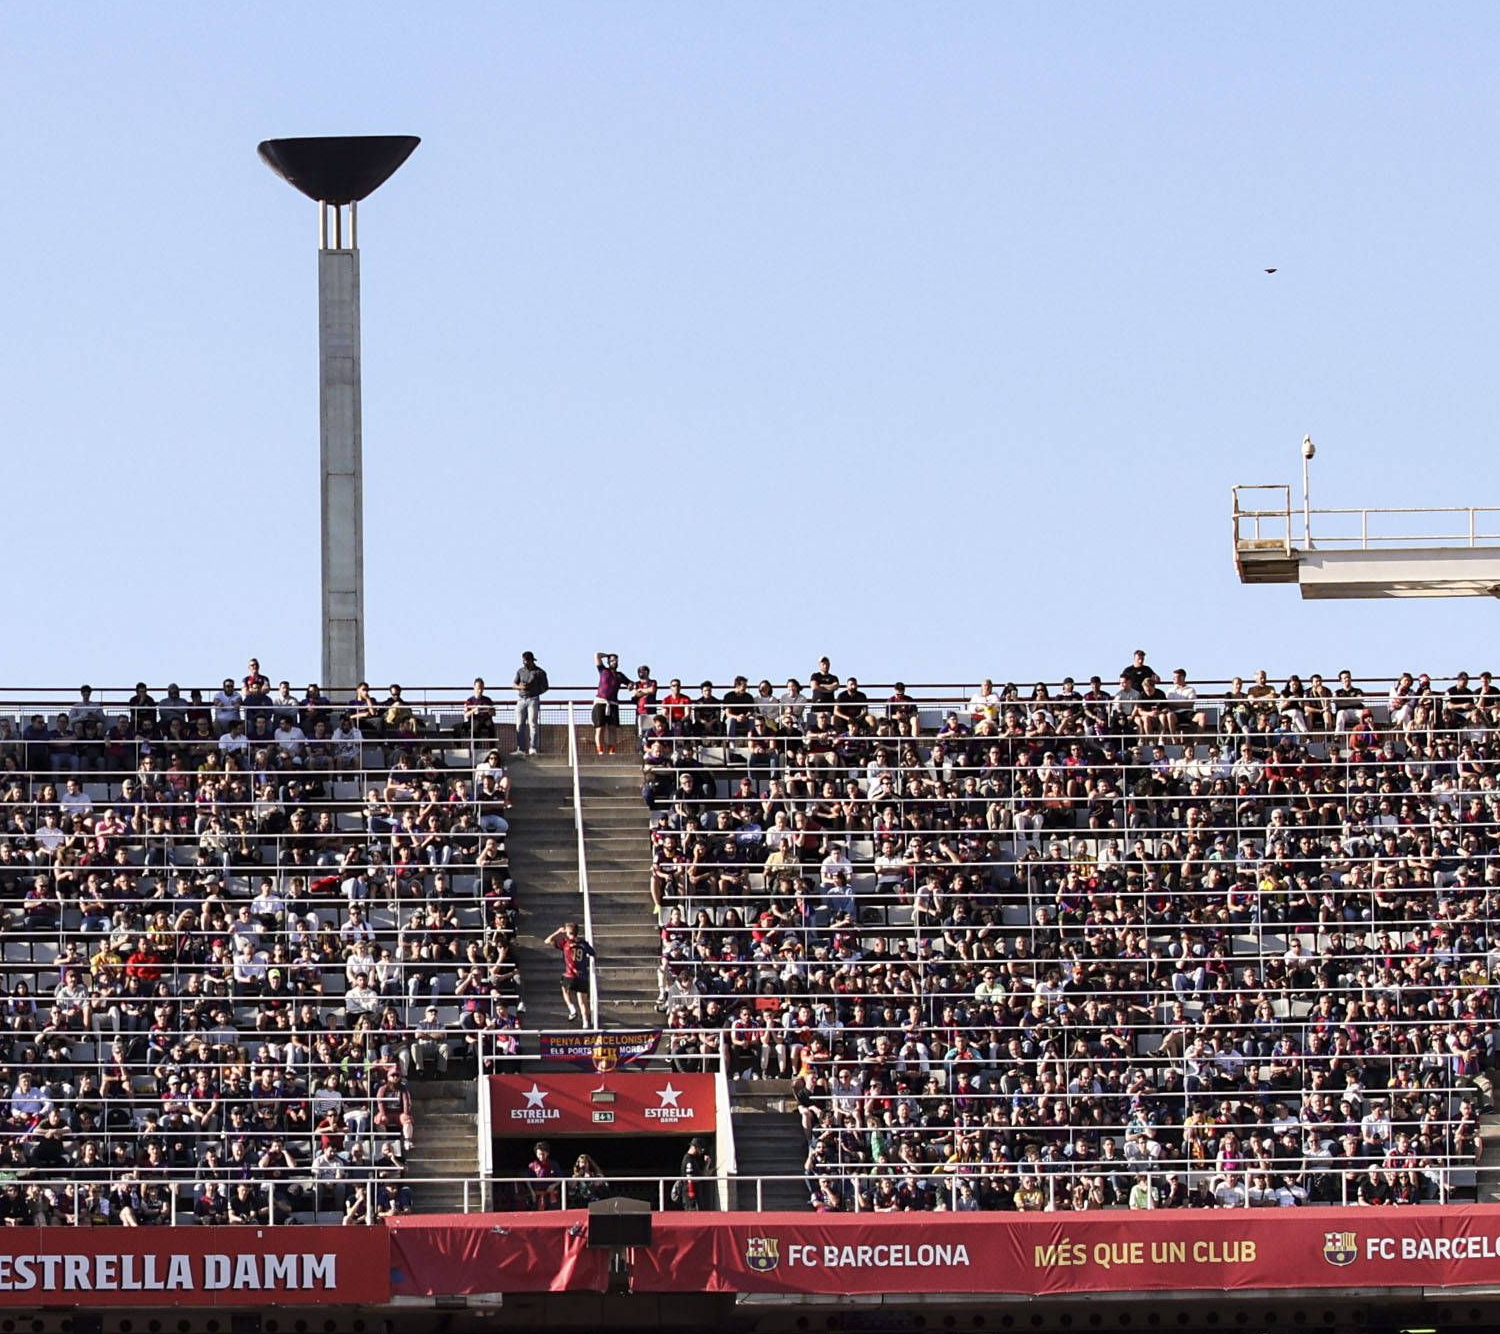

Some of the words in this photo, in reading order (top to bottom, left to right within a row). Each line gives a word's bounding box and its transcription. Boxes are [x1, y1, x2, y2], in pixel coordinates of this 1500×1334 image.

[550, 1037, 581, 1046] PENYA
[550, 1047, 564, 1055] ELS
[568, 1046, 592, 1055] PORTS
[511, 1109, 560, 1119] ESTRELLA
[645, 1108, 694, 1118] ESTRELLA
[788, 1246, 819, 1266] FC
[824, 1244, 970, 1266] BARCELONA
[1034, 1237, 1087, 1266] MÉS
[1093, 1242, 1144, 1269] QUE
[1151, 1241, 1191, 1264] UN
[1193, 1240, 1257, 1263] CLUB
[1366, 1238, 1395, 1259] FC
[203, 1253, 337, 1290] DAMM
